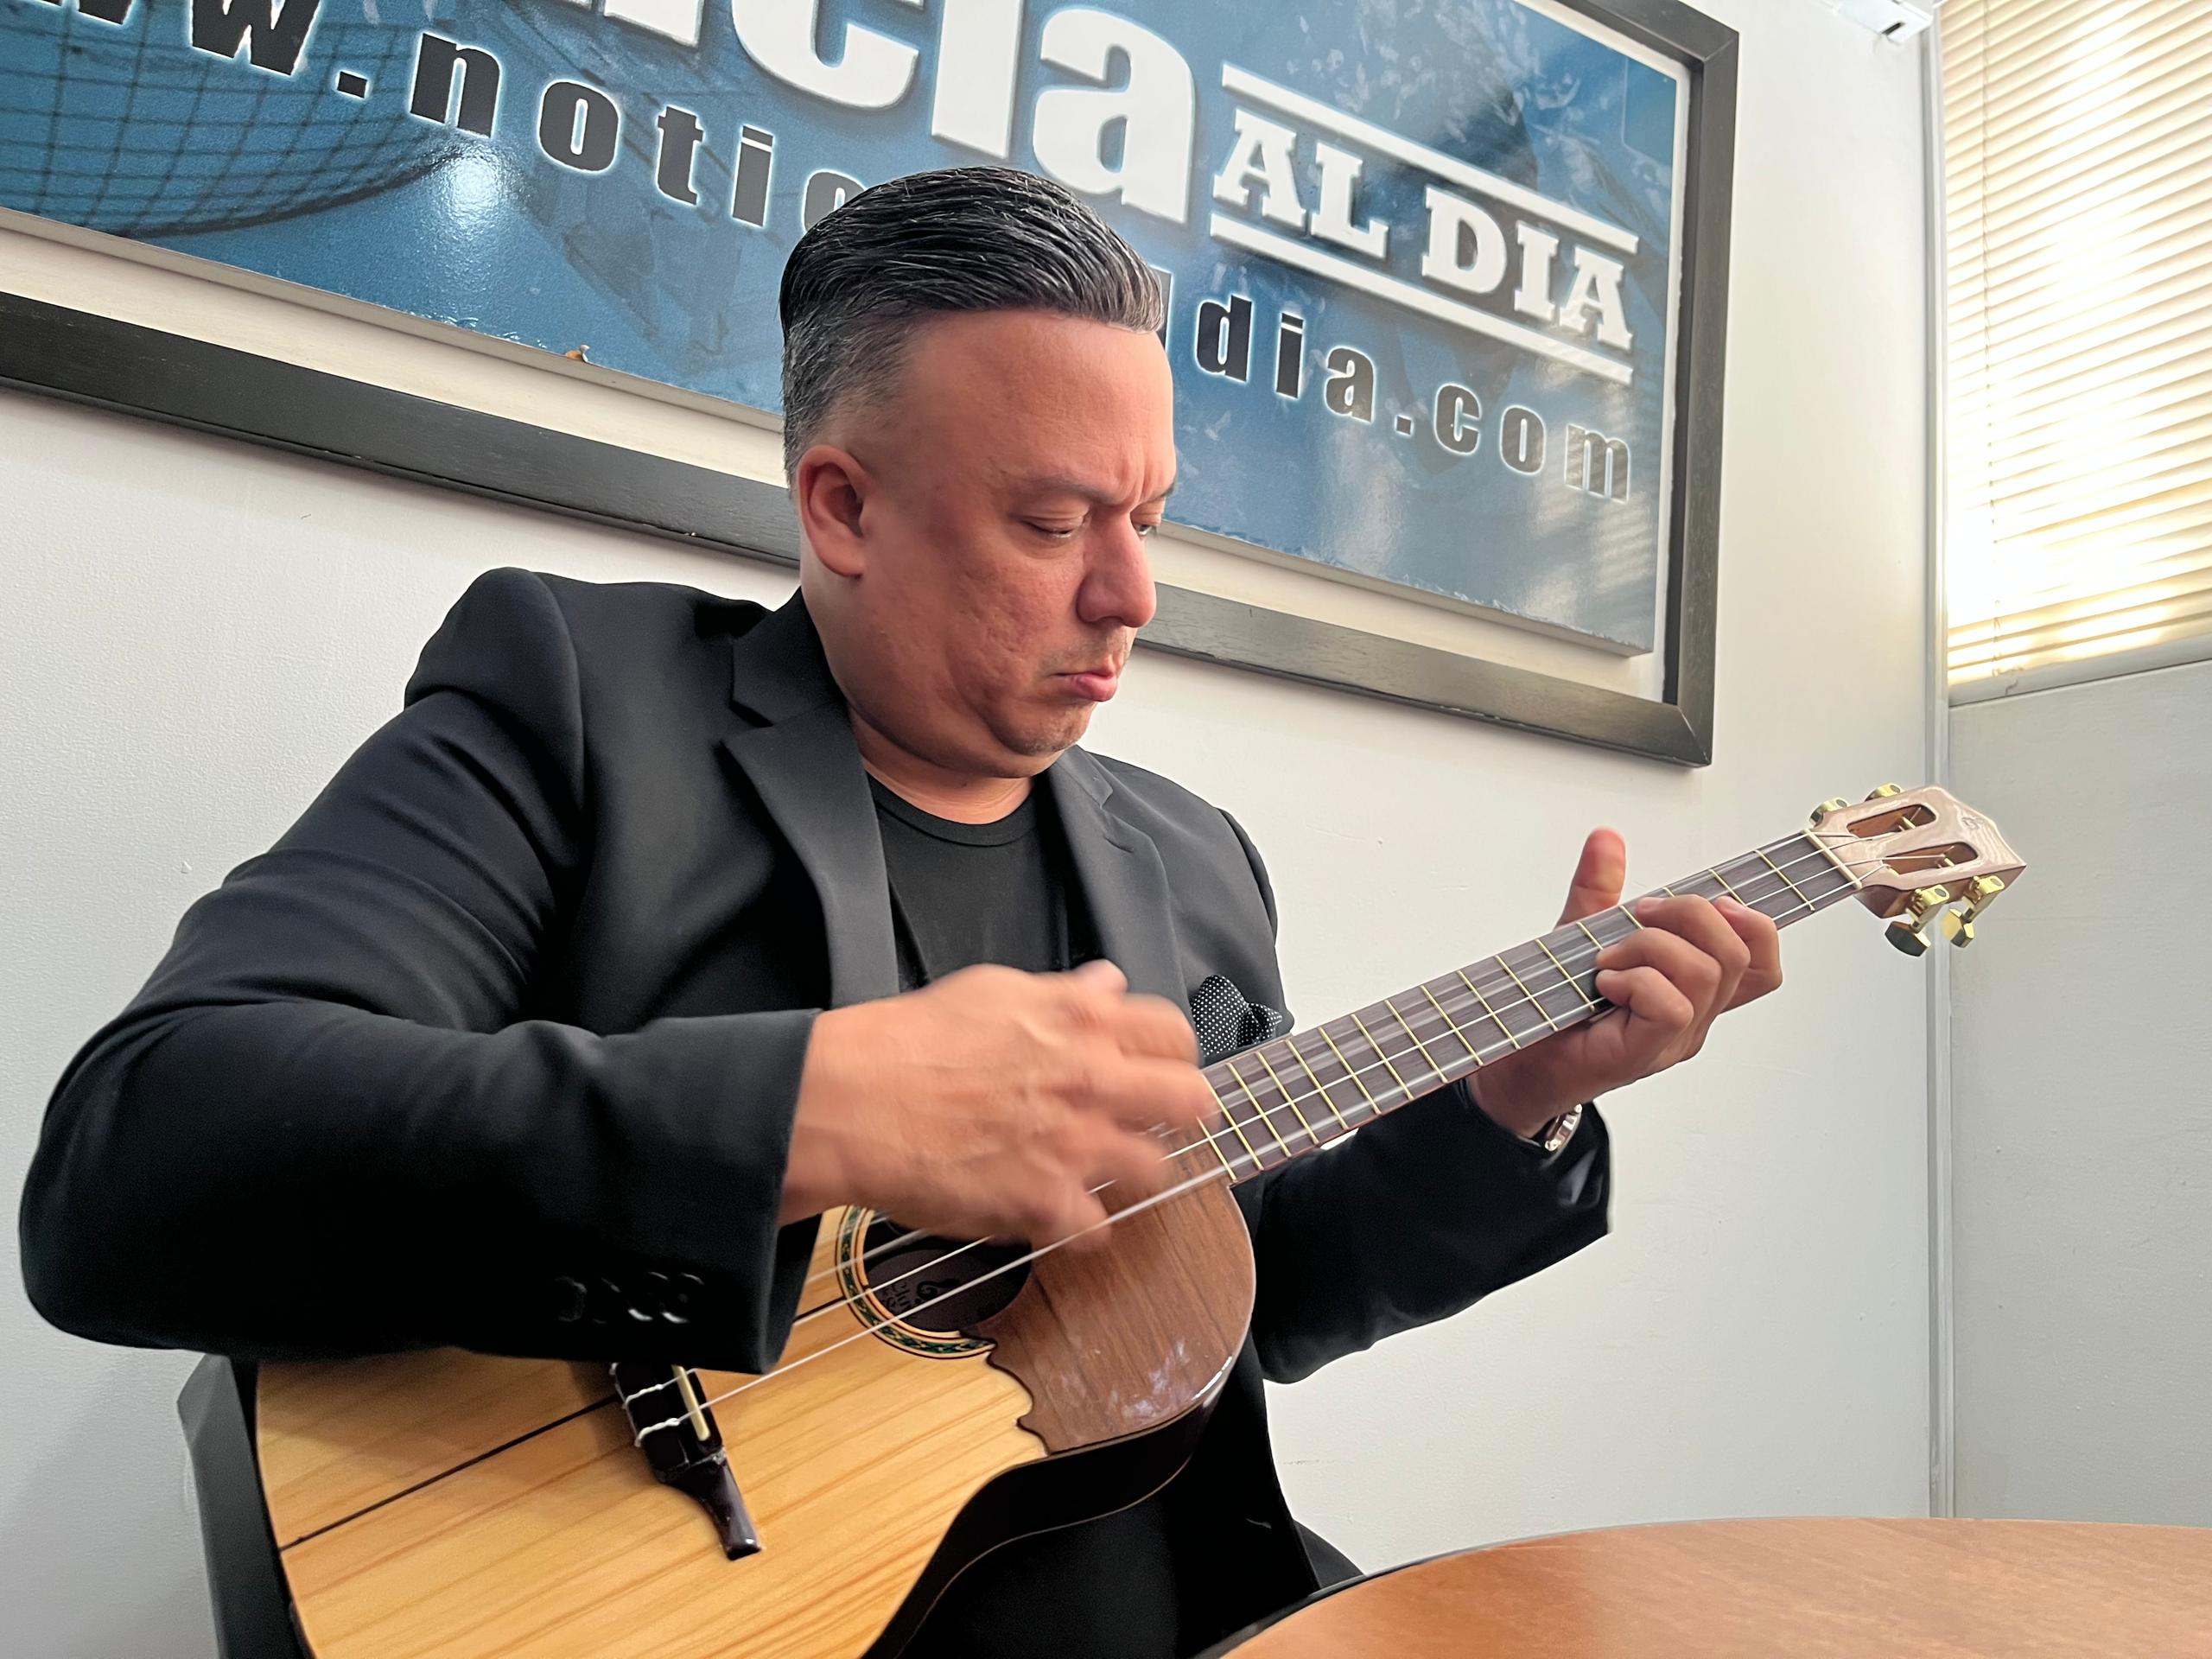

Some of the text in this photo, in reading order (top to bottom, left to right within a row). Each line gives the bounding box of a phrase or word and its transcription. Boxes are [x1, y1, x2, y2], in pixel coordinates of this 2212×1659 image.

[562, 0, 1196, 224] cia
[1213, 107, 1633, 350] AL DIA
